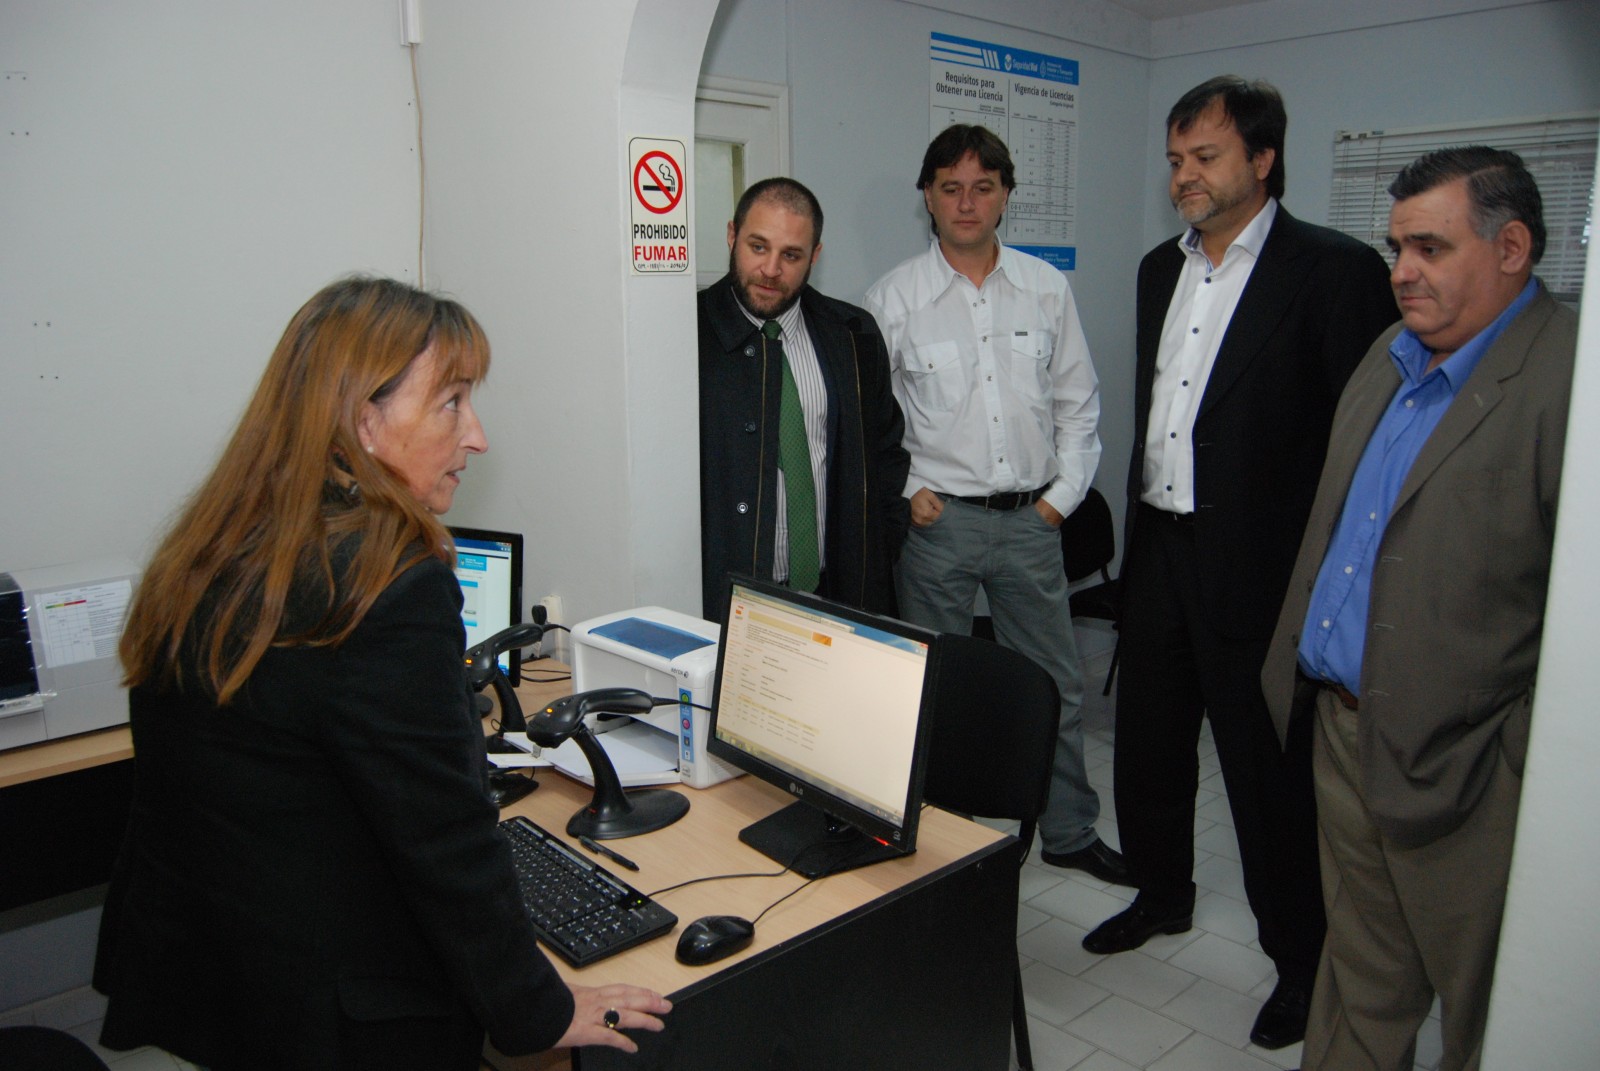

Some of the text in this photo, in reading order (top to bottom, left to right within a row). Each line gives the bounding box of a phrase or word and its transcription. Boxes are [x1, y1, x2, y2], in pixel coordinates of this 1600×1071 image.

[945, 71, 995, 89] Requisitos para
[936, 82, 1003, 102] Obtener una Licencia
[1014, 82, 1074, 102] Vigencia de Licencias
[634, 223, 686, 240] PROHIBIDO
[634, 245, 687, 261] FUMAR
[797, 785, 804, 796] LG
